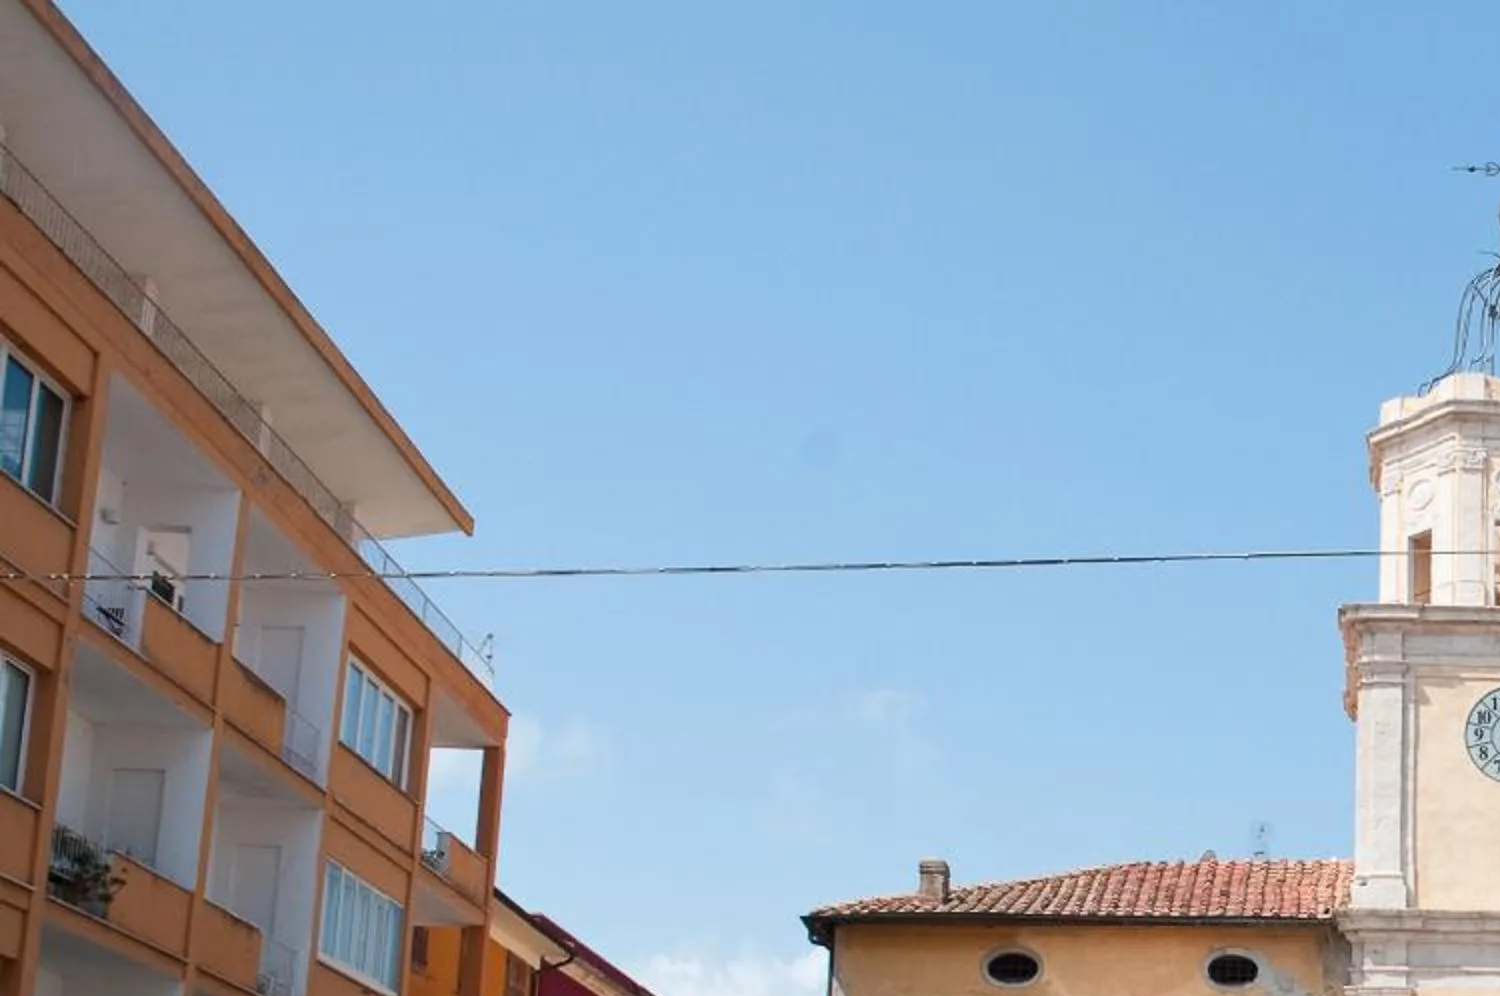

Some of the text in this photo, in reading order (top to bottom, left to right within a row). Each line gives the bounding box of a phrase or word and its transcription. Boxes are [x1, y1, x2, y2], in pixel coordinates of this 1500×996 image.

[1477, 711, 1491, 724] 10
[1473, 727, 1484, 741] 9
[1479, 746, 1488, 760] 8
